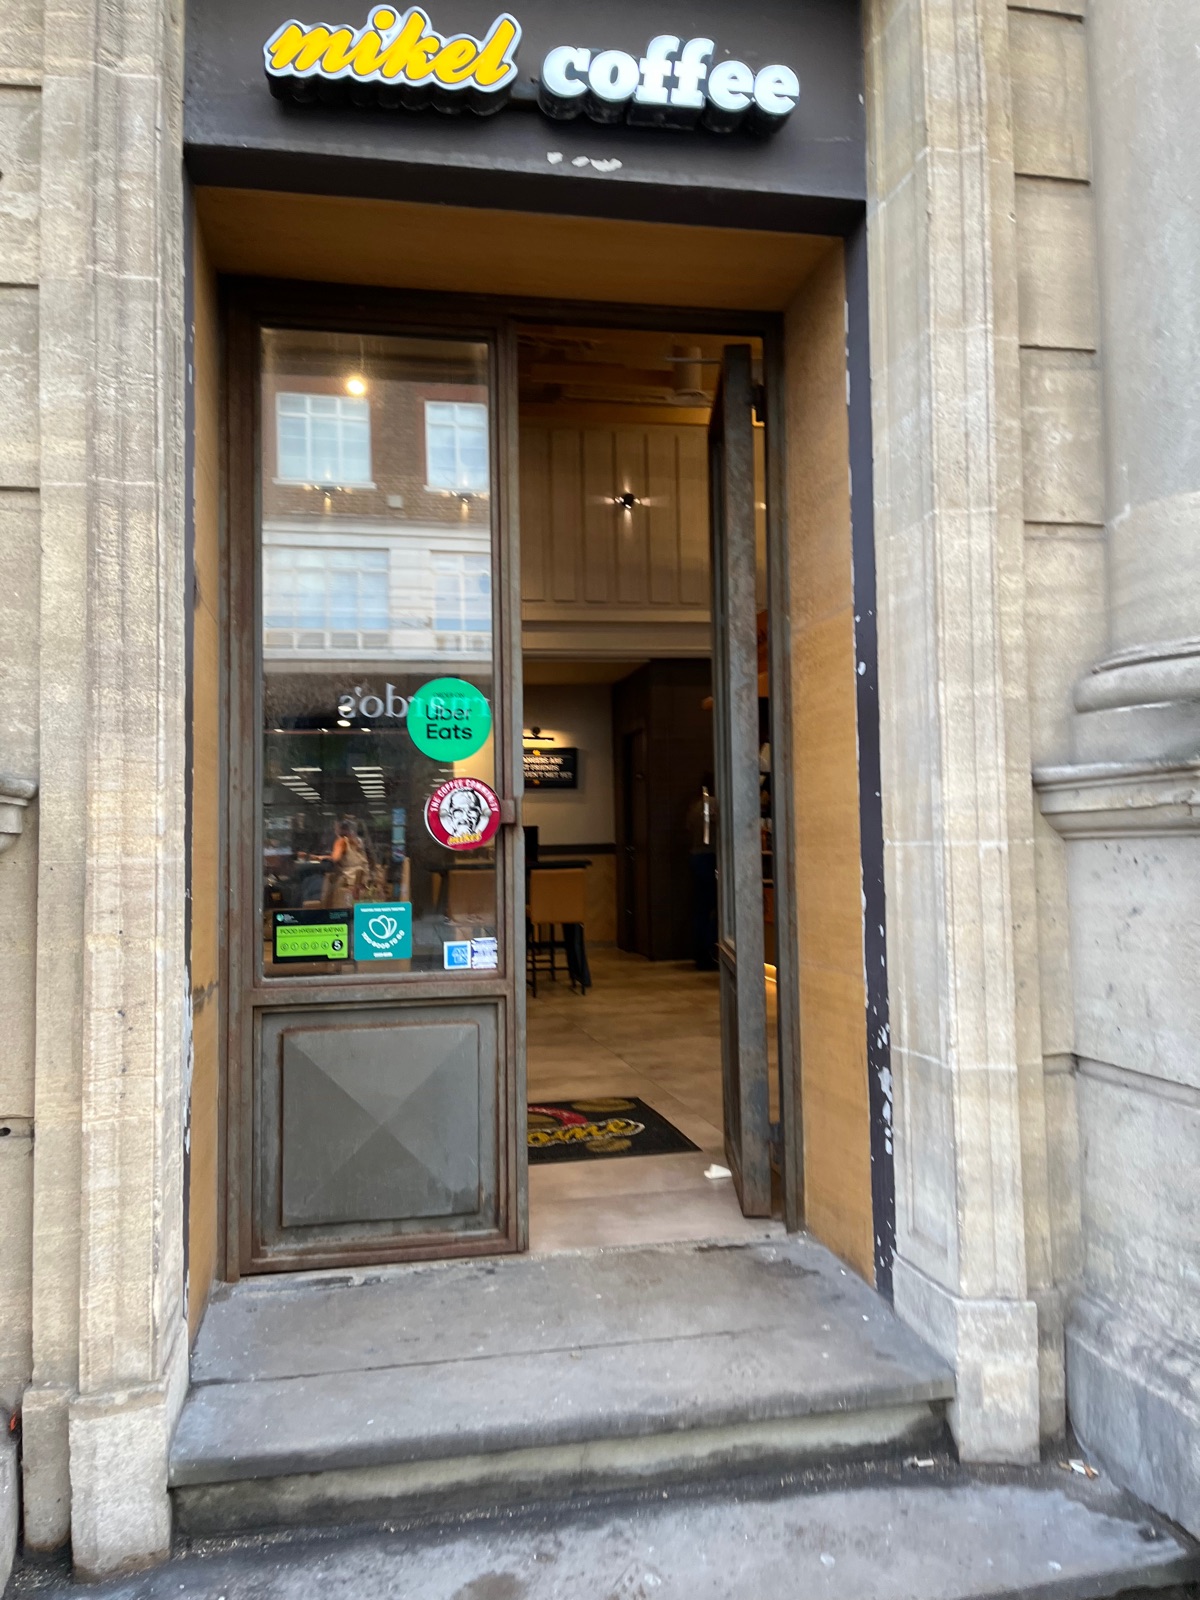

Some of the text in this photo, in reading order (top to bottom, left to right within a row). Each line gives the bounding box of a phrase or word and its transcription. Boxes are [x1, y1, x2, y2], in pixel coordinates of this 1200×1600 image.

[265, 5, 801, 114] mikel coffee
[425, 704, 473, 721] Uber
[426, 723, 473, 740] Eats
[429, 778, 499, 812] THE COFFEE COMMUNITY
[333, 940, 342, 951] 5
